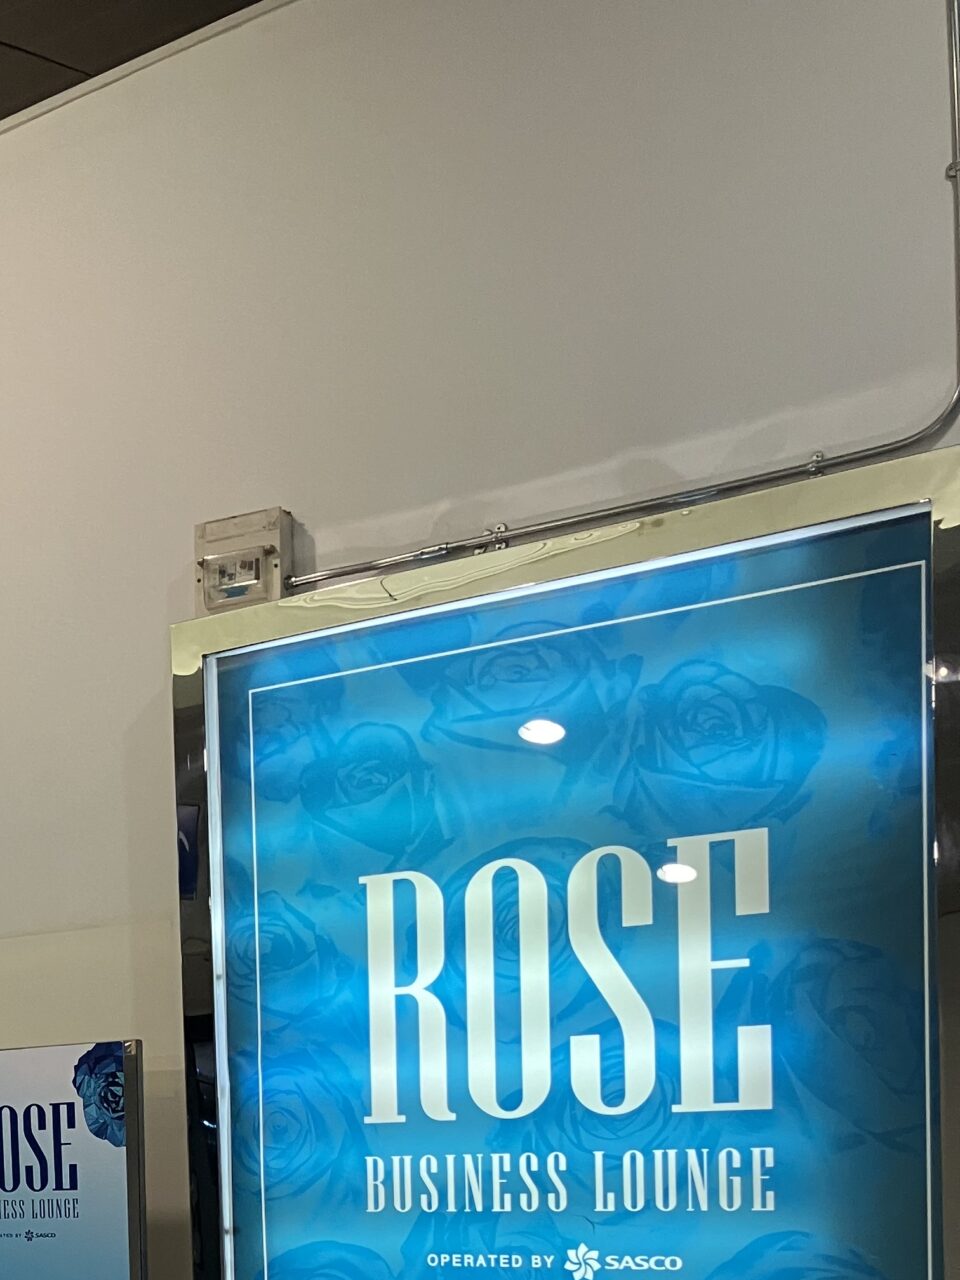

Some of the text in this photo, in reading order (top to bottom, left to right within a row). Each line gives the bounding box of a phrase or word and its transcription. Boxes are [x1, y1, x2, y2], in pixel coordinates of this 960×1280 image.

[358, 827, 774, 1124] ROSE
[364, 1147, 776, 1214] BUSINESS LOUNGE
[31, 1198, 80, 1220] LOUNGE
[34, 1231, 57, 1239] SASCO
[426, 1252, 683, 1271] OPERATED BY SASCO
